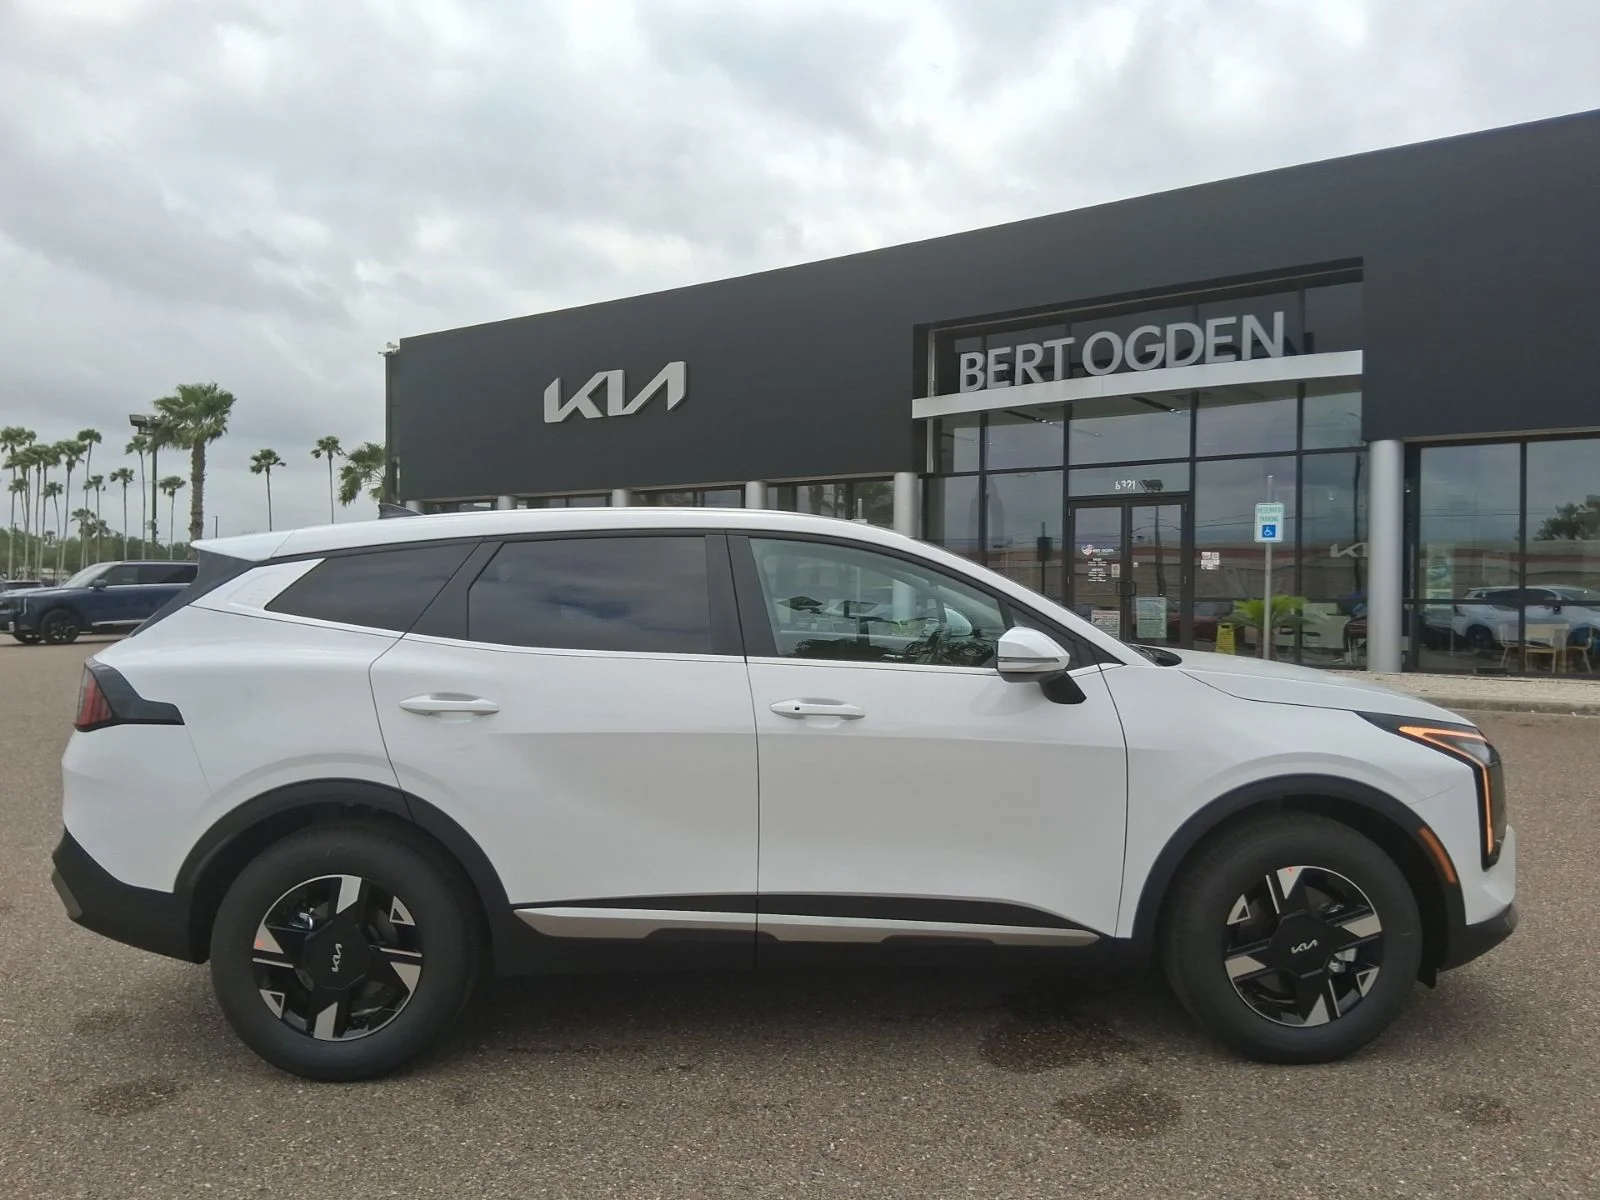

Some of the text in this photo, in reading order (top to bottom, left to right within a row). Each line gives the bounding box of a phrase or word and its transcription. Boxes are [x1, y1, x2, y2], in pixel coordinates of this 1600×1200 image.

[959, 311, 1285, 393] BERT OGDEN
[544, 361, 686, 423] KIA
[331, 943, 342, 972] KIA
[1291, 939, 1318, 954] KIA
